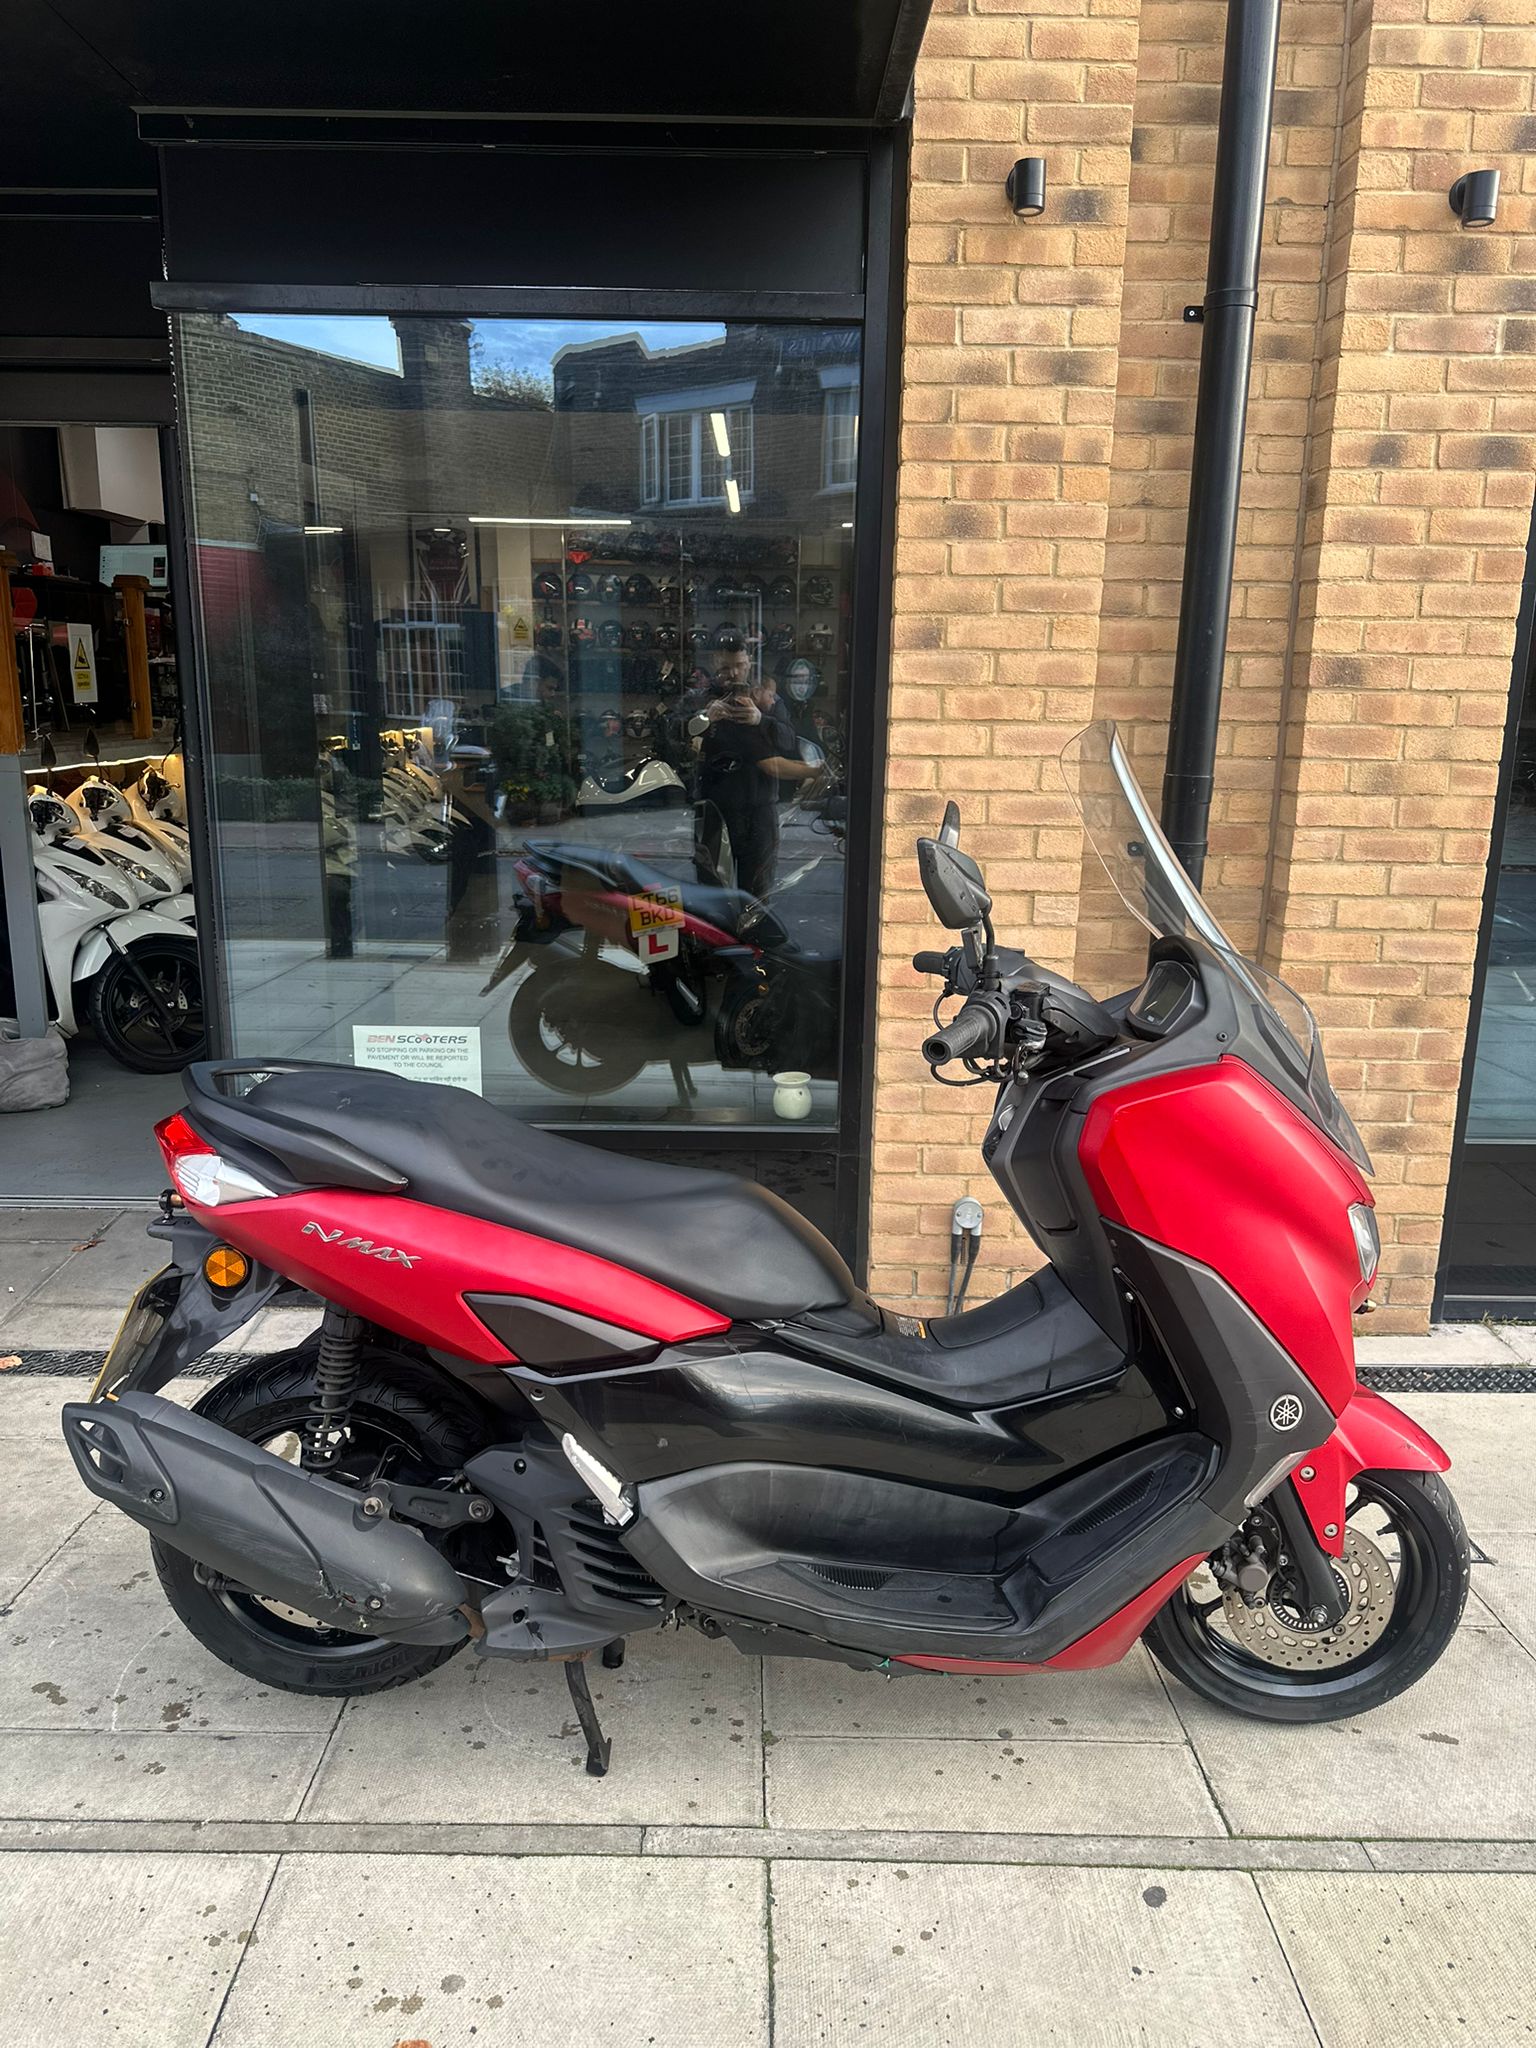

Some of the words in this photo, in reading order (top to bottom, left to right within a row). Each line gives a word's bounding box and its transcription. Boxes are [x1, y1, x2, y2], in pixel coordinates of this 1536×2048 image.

[632, 888, 679, 911] LT66
[640, 906, 676, 926] BKD
[648, 933, 669, 955] L
[367, 1034, 396, 1044] BEN
[396, 1034, 468, 1044] SCOOTERS
[301, 1221, 422, 1269] NMAX
